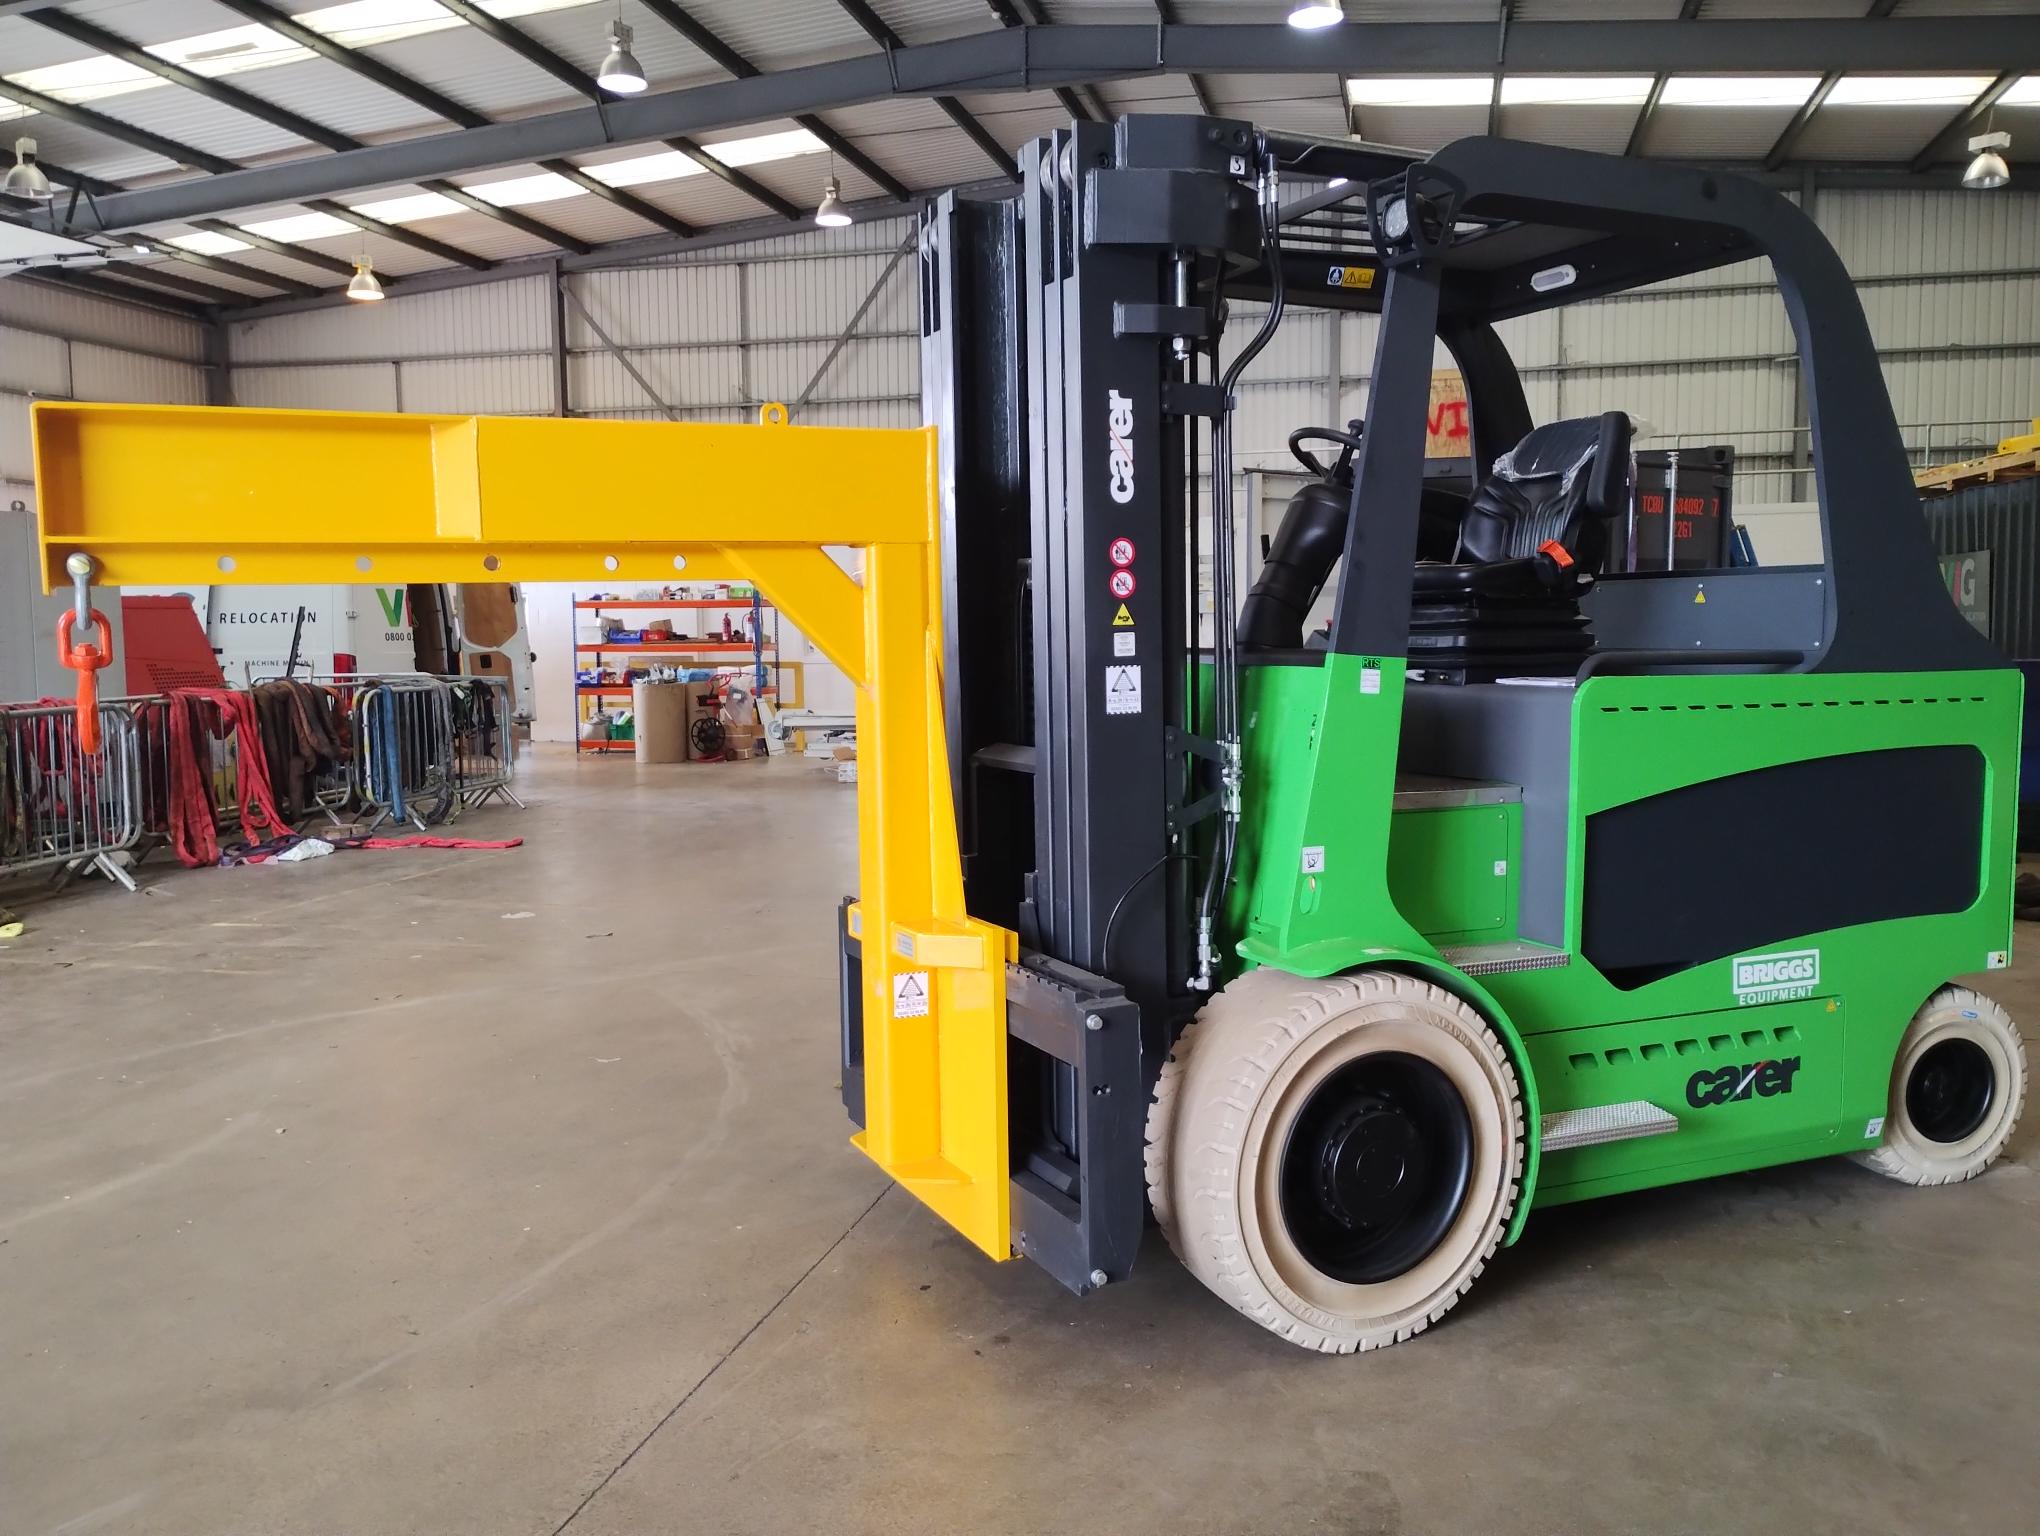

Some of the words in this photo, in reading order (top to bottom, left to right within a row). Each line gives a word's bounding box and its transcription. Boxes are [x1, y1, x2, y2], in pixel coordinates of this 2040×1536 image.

[1108, 389, 1135, 504] carer
[220, 612, 316, 624] RELOCATIN
[384, 632, 405, 641] 0800
[406, 632, 414, 641] 0
[1362, 657, 1380, 669] RTS
[1738, 957, 1814, 986] BRIGGS
[1739, 985, 1814, 1006] EQUIPMENT
[1686, 1055, 1801, 1108] carer
